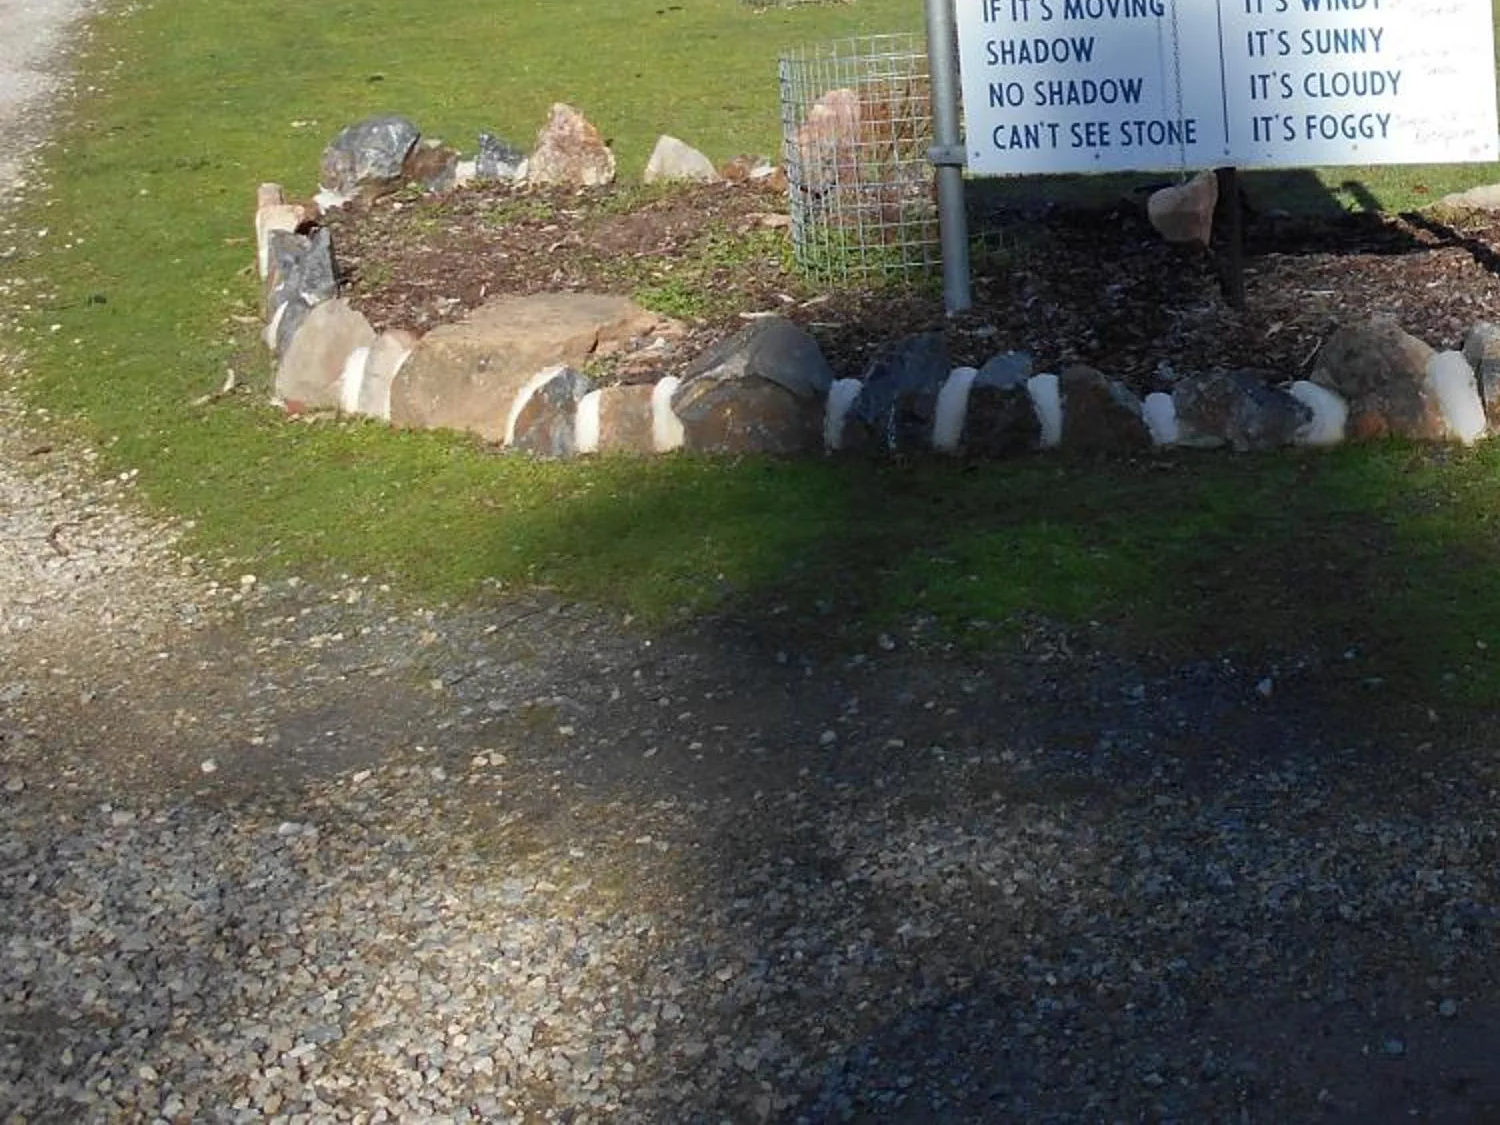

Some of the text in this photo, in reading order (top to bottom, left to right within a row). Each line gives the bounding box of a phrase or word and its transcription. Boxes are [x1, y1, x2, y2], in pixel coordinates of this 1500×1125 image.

[985, 36, 1095, 67] SHADOW
[1247, 28, 1292, 58] IT'S
[1300, 26, 1384, 56] SUNNY
[988, 77, 1144, 108] NO SHADOW
[1249, 70, 1401, 101] IT'S CLOUDY
[991, 118, 1198, 152] CAN'T SEE STONE
[1251, 113, 1297, 143] IT'S
[1305, 112, 1391, 141] FOGGY
